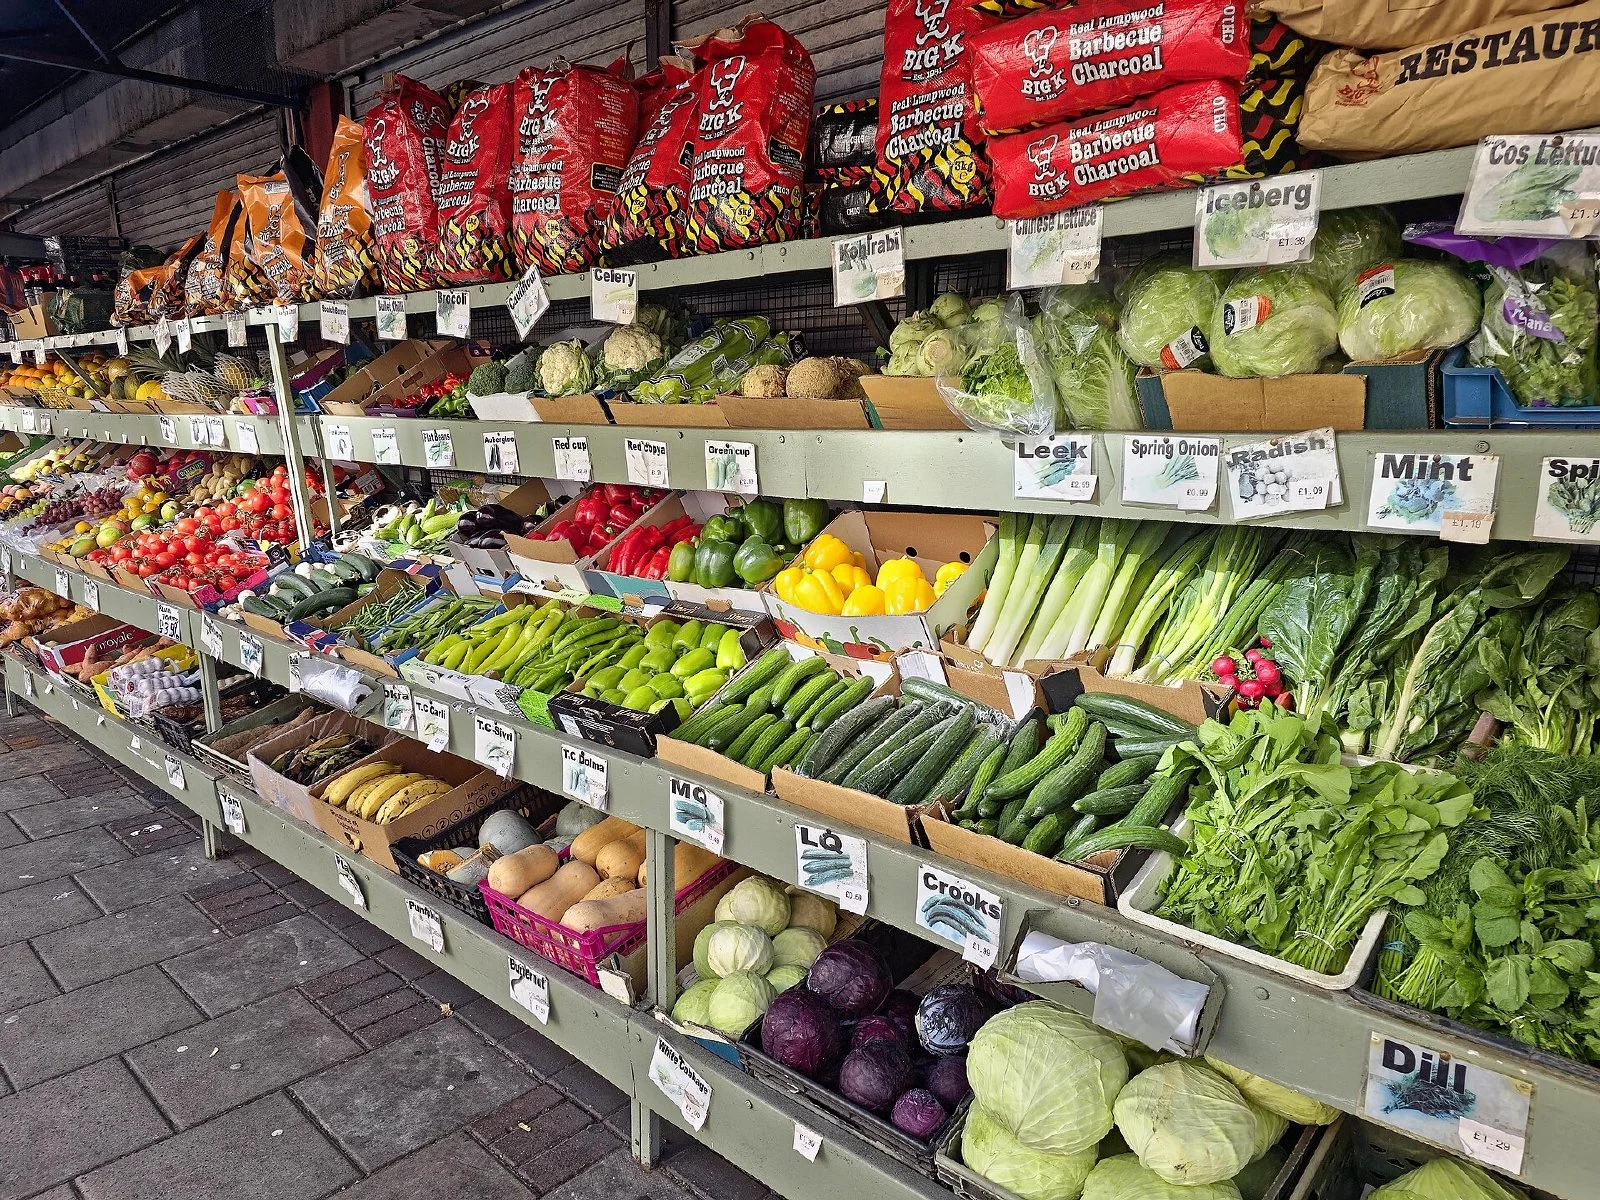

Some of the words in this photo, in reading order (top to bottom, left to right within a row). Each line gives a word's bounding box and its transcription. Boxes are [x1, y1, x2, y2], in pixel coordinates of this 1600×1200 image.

[1069, 20, 1097, 36] Real
[1097, 3, 1164, 30] Lumpwood
[1221, 5, 1236, 44] CH10
[902, 48, 940, 71] BIG
[941, 31, 965, 61] K
[1069, 24, 1162, 61] Barbecue
[1071, 46, 1163, 86] Charcoal
[1021, 78, 1052, 96] BIG
[1050, 69, 1067, 88] K
[892, 98, 911, 114] Real
[912, 82, 965, 107] Lumpwood
[520, 116, 541, 136] BIG
[542, 107, 558, 133] K
[700, 114, 725, 132] BIG
[727, 104, 743, 125] K
[890, 102, 964, 135] Barbecue
[1069, 127, 1093, 141] Real
[1094, 107, 1159, 133] Lumpwood
[1213, 95, 1227, 133] CH10
[448, 140, 471, 158] BIG
[467, 135, 480, 153] K
[704, 147, 745, 161] Lumpwood
[889, 122, 960, 160] Charcoal
[1070, 122, 1155, 164] Barbecue
[1489, 140, 1530, 166] Cos
[369, 168, 393, 186] BIG
[692, 161, 744, 185] Barbecue
[955, 160, 974, 173] 3kg
[1073, 144, 1160, 186] Charcoal
[508, 175, 562, 193] Barbecue
[690, 176, 741, 202] Charcoal
[1028, 181, 1055, 197] BIG
[1053, 171, 1070, 191] K
[1205, 183, 1312, 214] Iceberg
[1015, 212, 1055, 236] Chinese
[1057, 208, 1098, 231] Lettuce
[594, 269, 635, 287] Celery
[1070, 261, 1092, 271] £2.99
[435, 432, 450, 441] Beans
[555, 440, 570, 450] Red
[572, 442, 587, 452] cup
[627, 440, 642, 451] Red
[1018, 441, 1088, 459] Leek
[1131, 439, 1174, 459] Spring
[1178, 440, 1218, 457] Onion
[708, 446, 734, 455] Green
[735, 448, 750, 457] cup
[1231, 437, 1326, 467] Radish
[1381, 454, 1474, 482] Mint
[1298, 486, 1323, 496] £1.09
[580, 754, 605, 773] Dolma
[467, 782, 490, 799] PACKER
[801, 826, 844, 855] LQ
[923, 872, 1001, 920] Crooks
[509, 956, 547, 990] Butternut
[658, 1039, 679, 1065] White
[678, 1055, 709, 1095] Cabbage
[1382, 1039, 1467, 1095] Dill
[1473, 1130, 1511, 1151] £1.29
